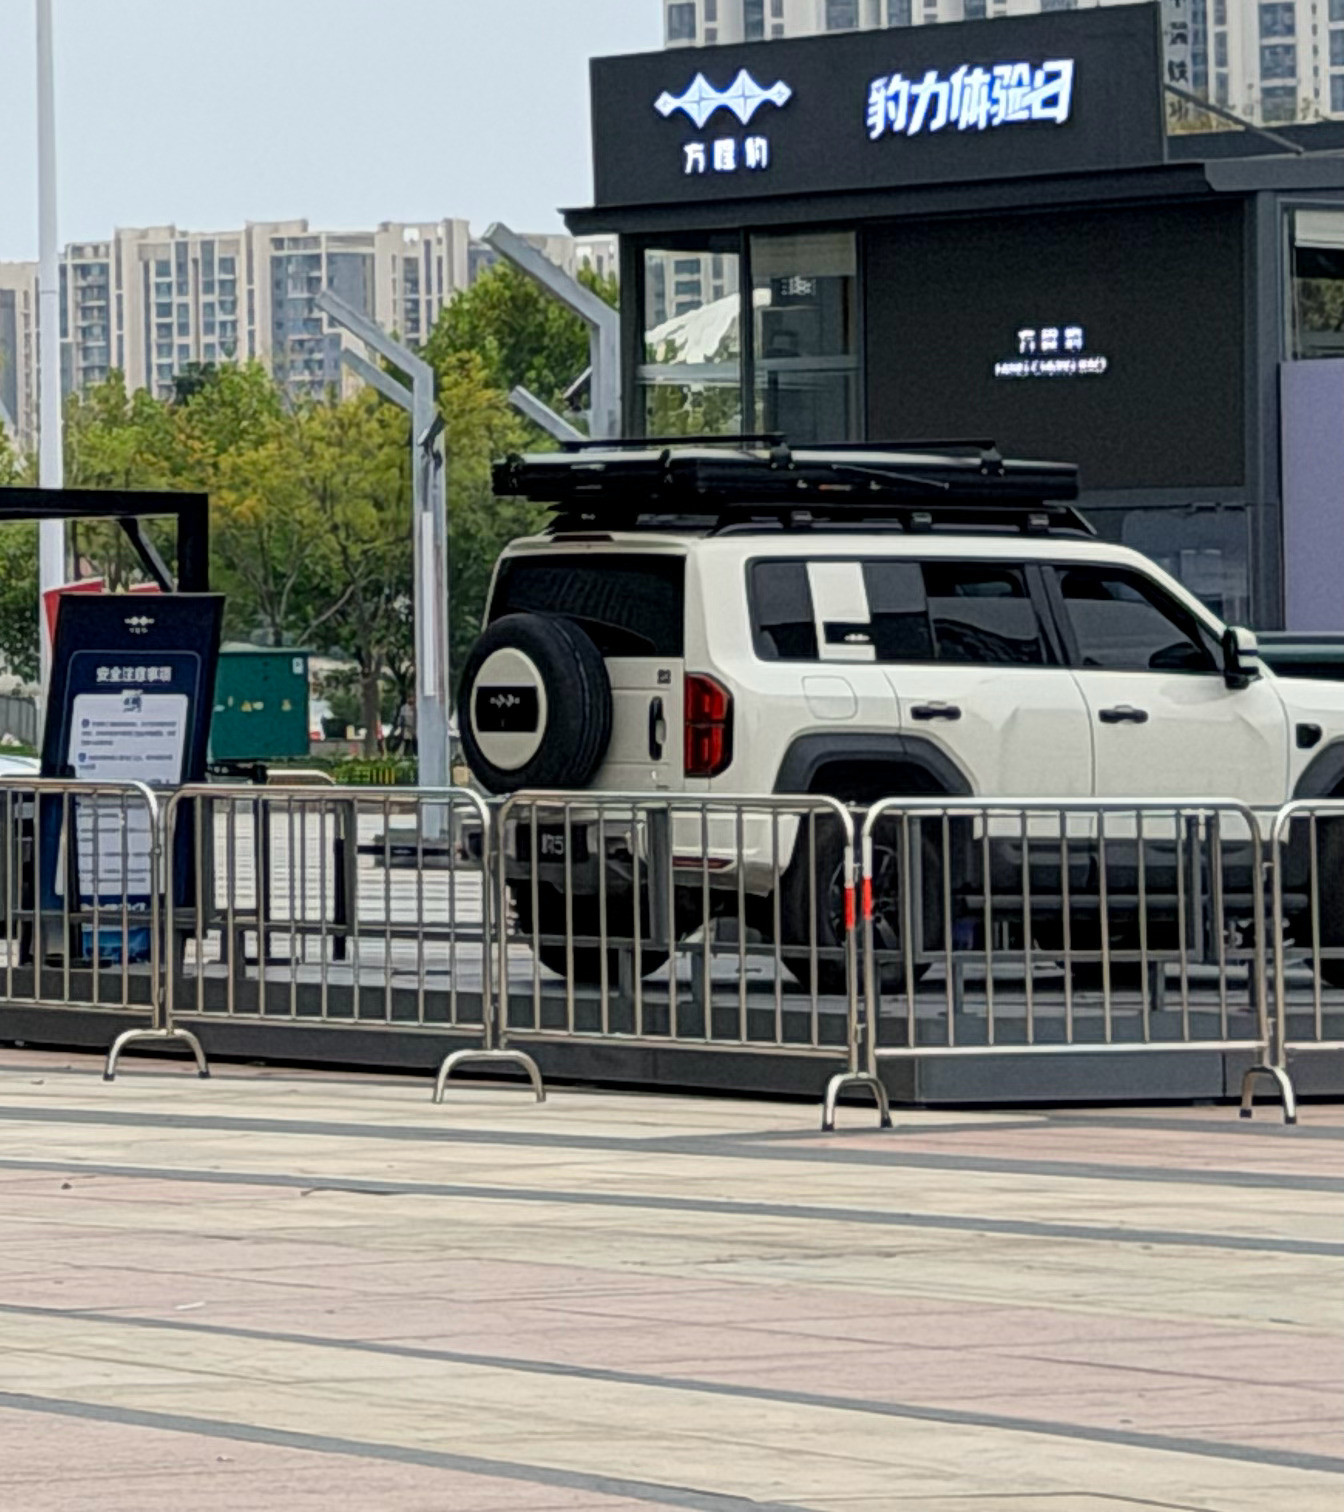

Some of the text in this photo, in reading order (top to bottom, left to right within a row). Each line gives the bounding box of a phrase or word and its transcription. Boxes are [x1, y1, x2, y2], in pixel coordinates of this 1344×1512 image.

[866, 58, 1075, 141] 豹力体验日
[683, 136, 769, 175] 方程豹
